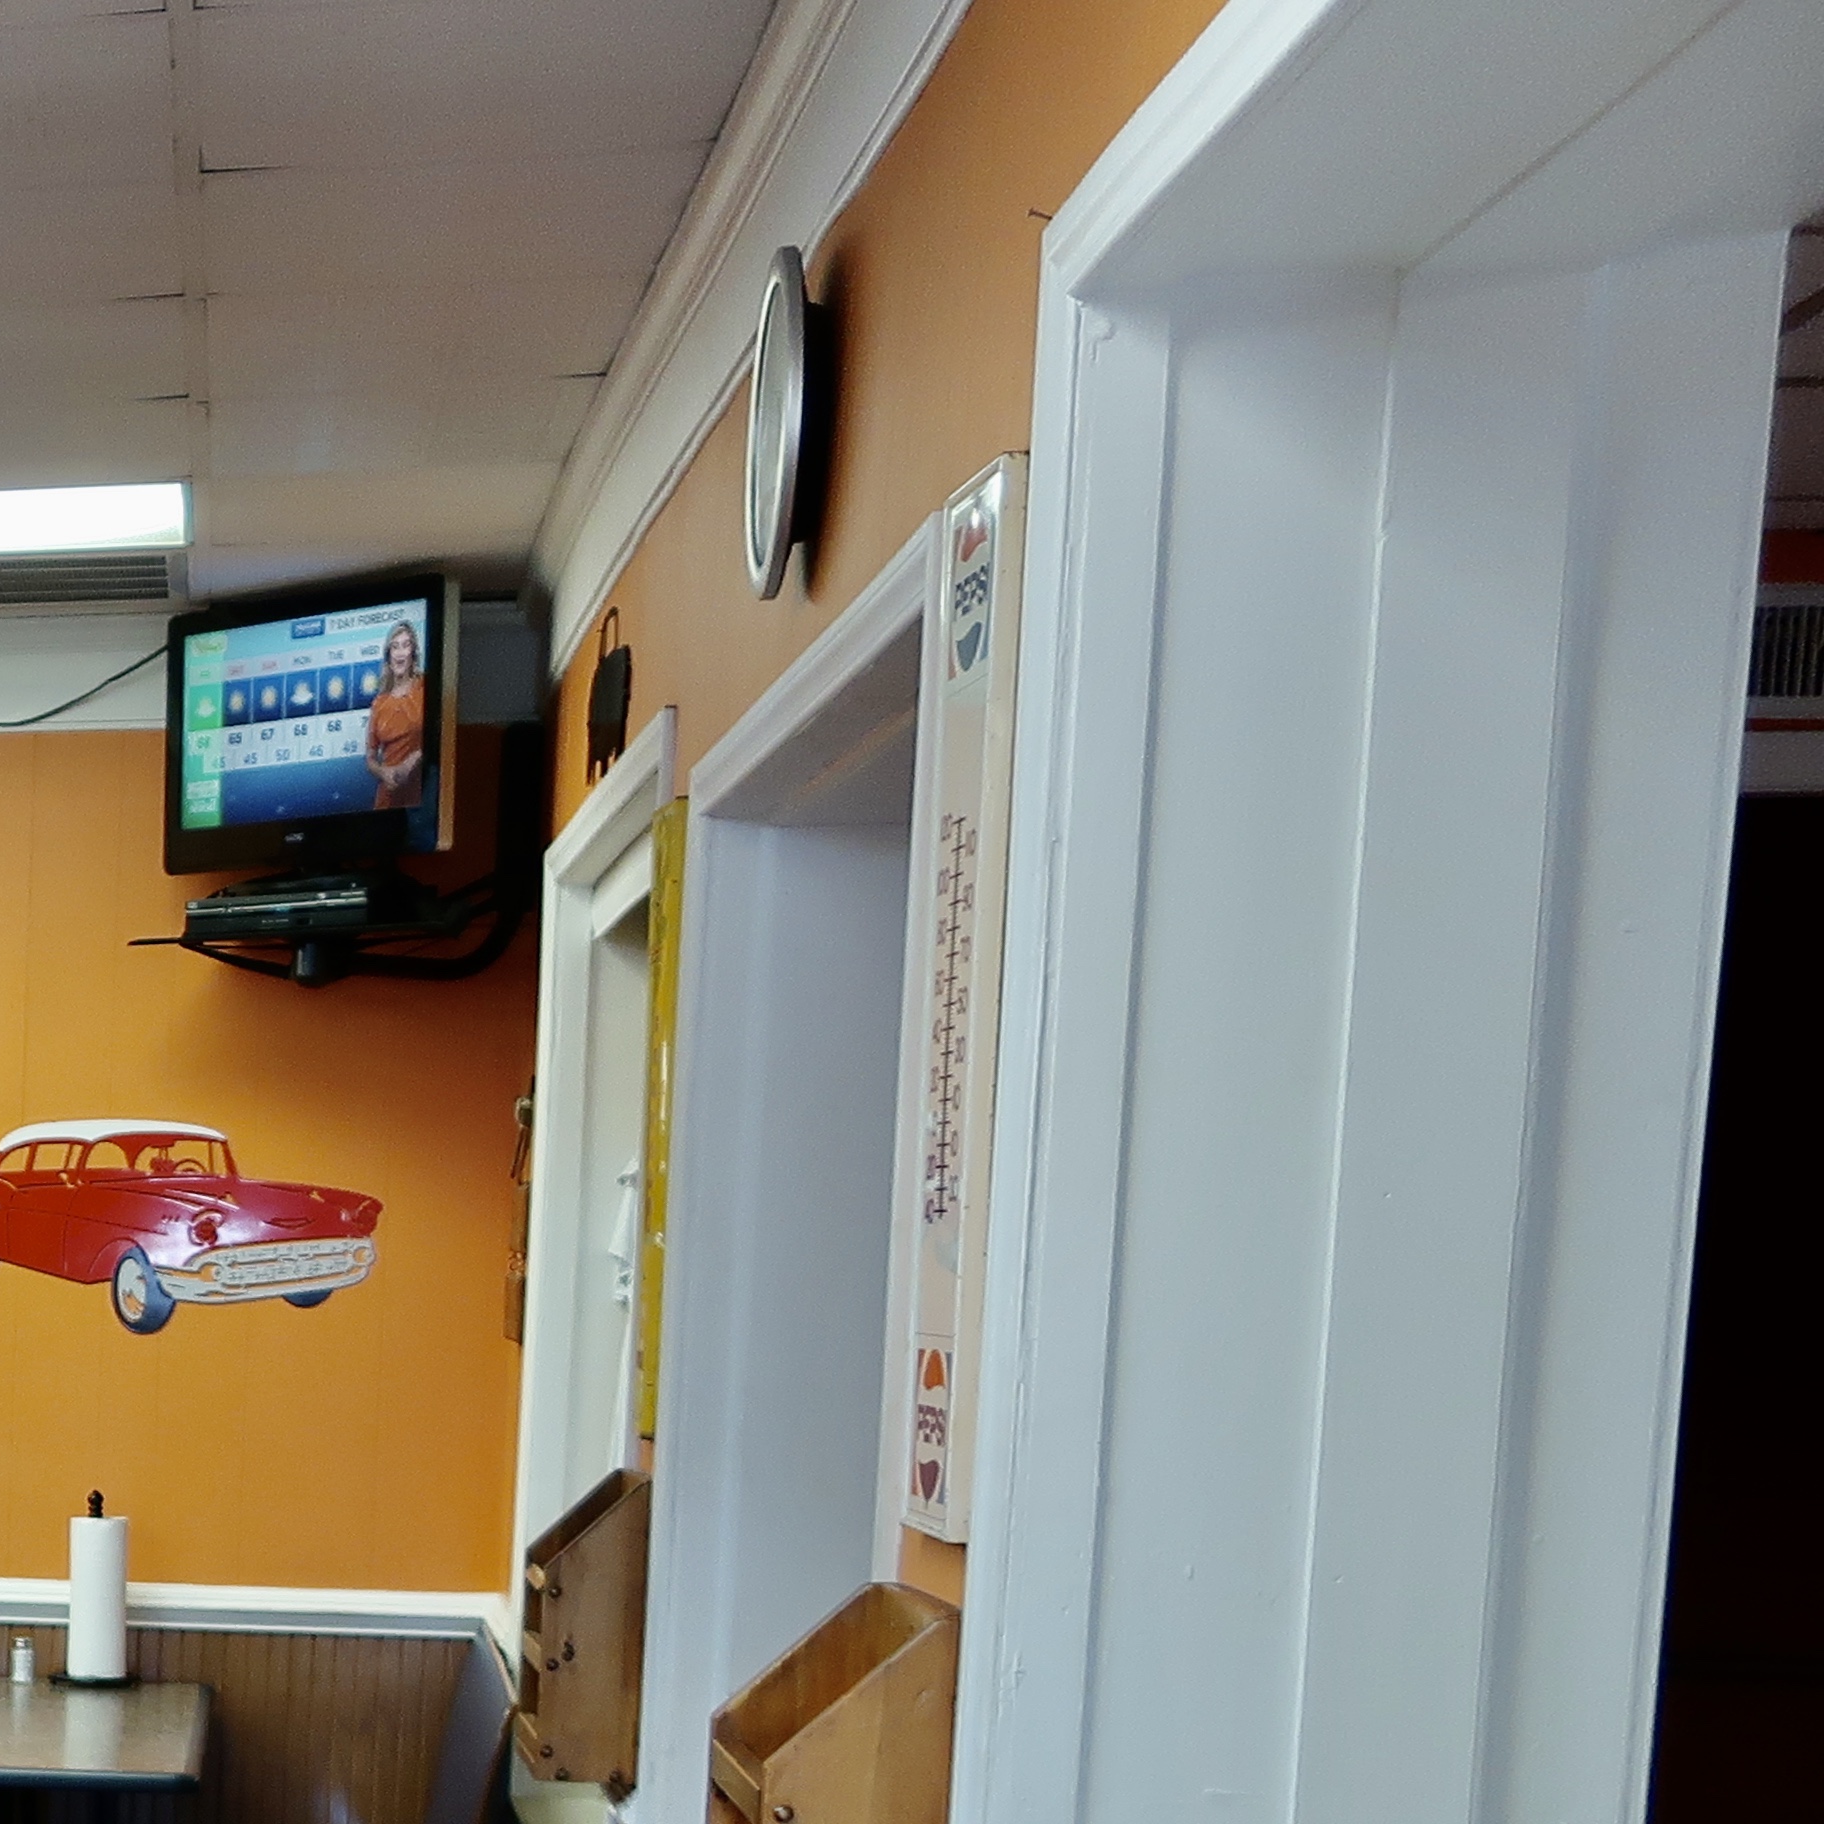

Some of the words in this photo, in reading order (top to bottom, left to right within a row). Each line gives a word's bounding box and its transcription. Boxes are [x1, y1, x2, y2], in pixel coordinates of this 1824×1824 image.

[954, 561, 989, 617] PEPSI
[261, 727, 274, 740] 67
[917, 1403, 947, 1447] PEPSI
